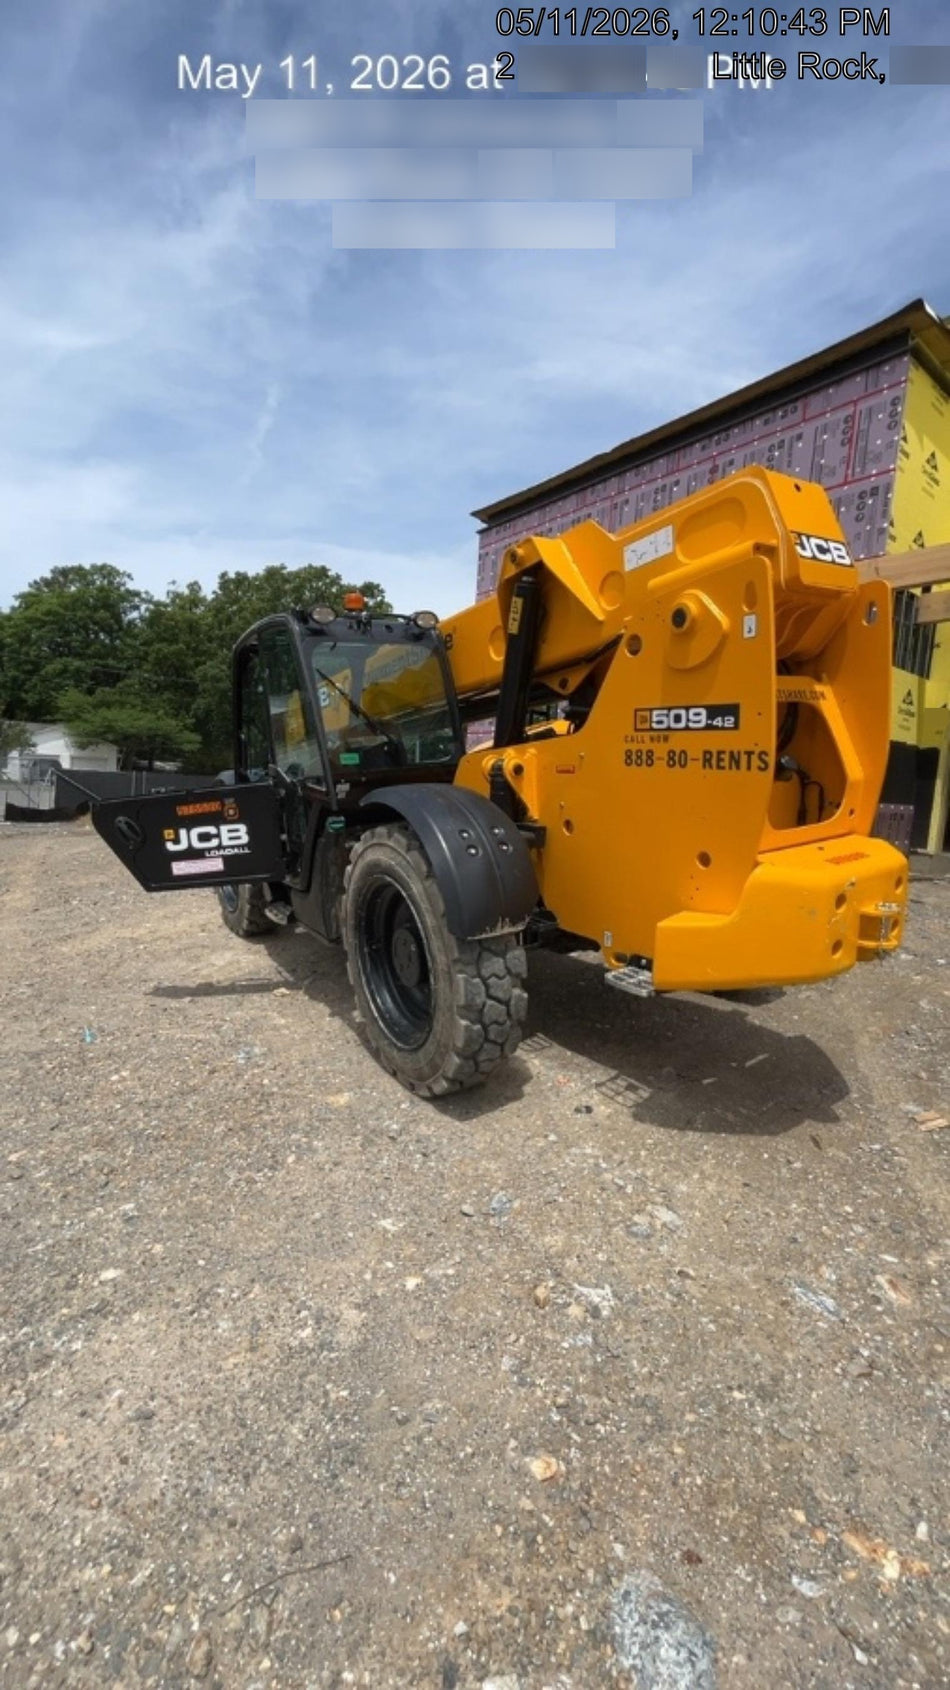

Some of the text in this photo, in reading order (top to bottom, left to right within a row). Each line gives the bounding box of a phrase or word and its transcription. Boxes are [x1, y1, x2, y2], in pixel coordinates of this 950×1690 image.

[795, 535, 851, 566] JCB
[624, 734, 670, 744] CALL NOW
[624, 749, 770, 772] 888-80-RENTS
[165, 823, 249, 851] JCB
[205, 848, 252, 857] LOADALL
